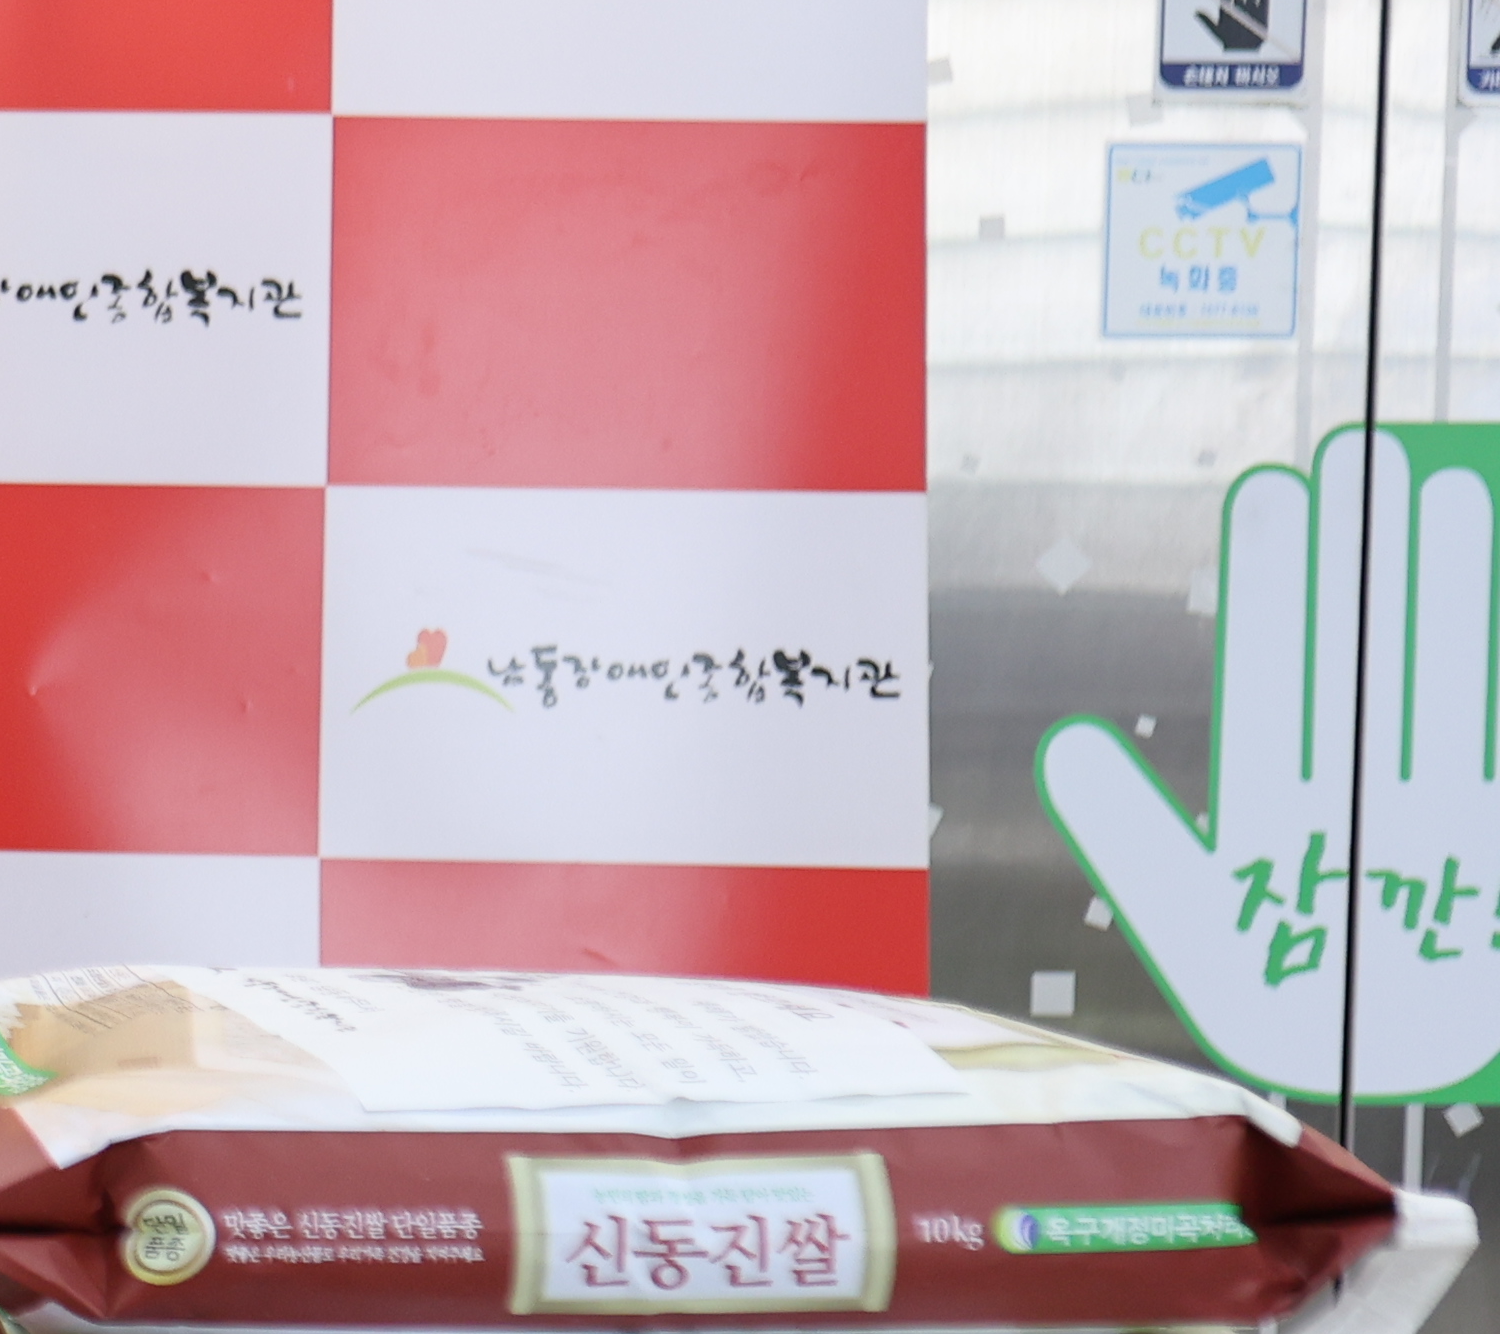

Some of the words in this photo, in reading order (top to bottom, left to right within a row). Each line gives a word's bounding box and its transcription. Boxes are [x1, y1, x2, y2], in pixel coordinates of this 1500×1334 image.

[1138, 226, 1267, 260] CCTV
[488, 646, 901, 706] 남동장애인종합복지관
[566, 1214, 848, 1290] 신동진쌀
[918, 1215, 983, 1250] 10kg
